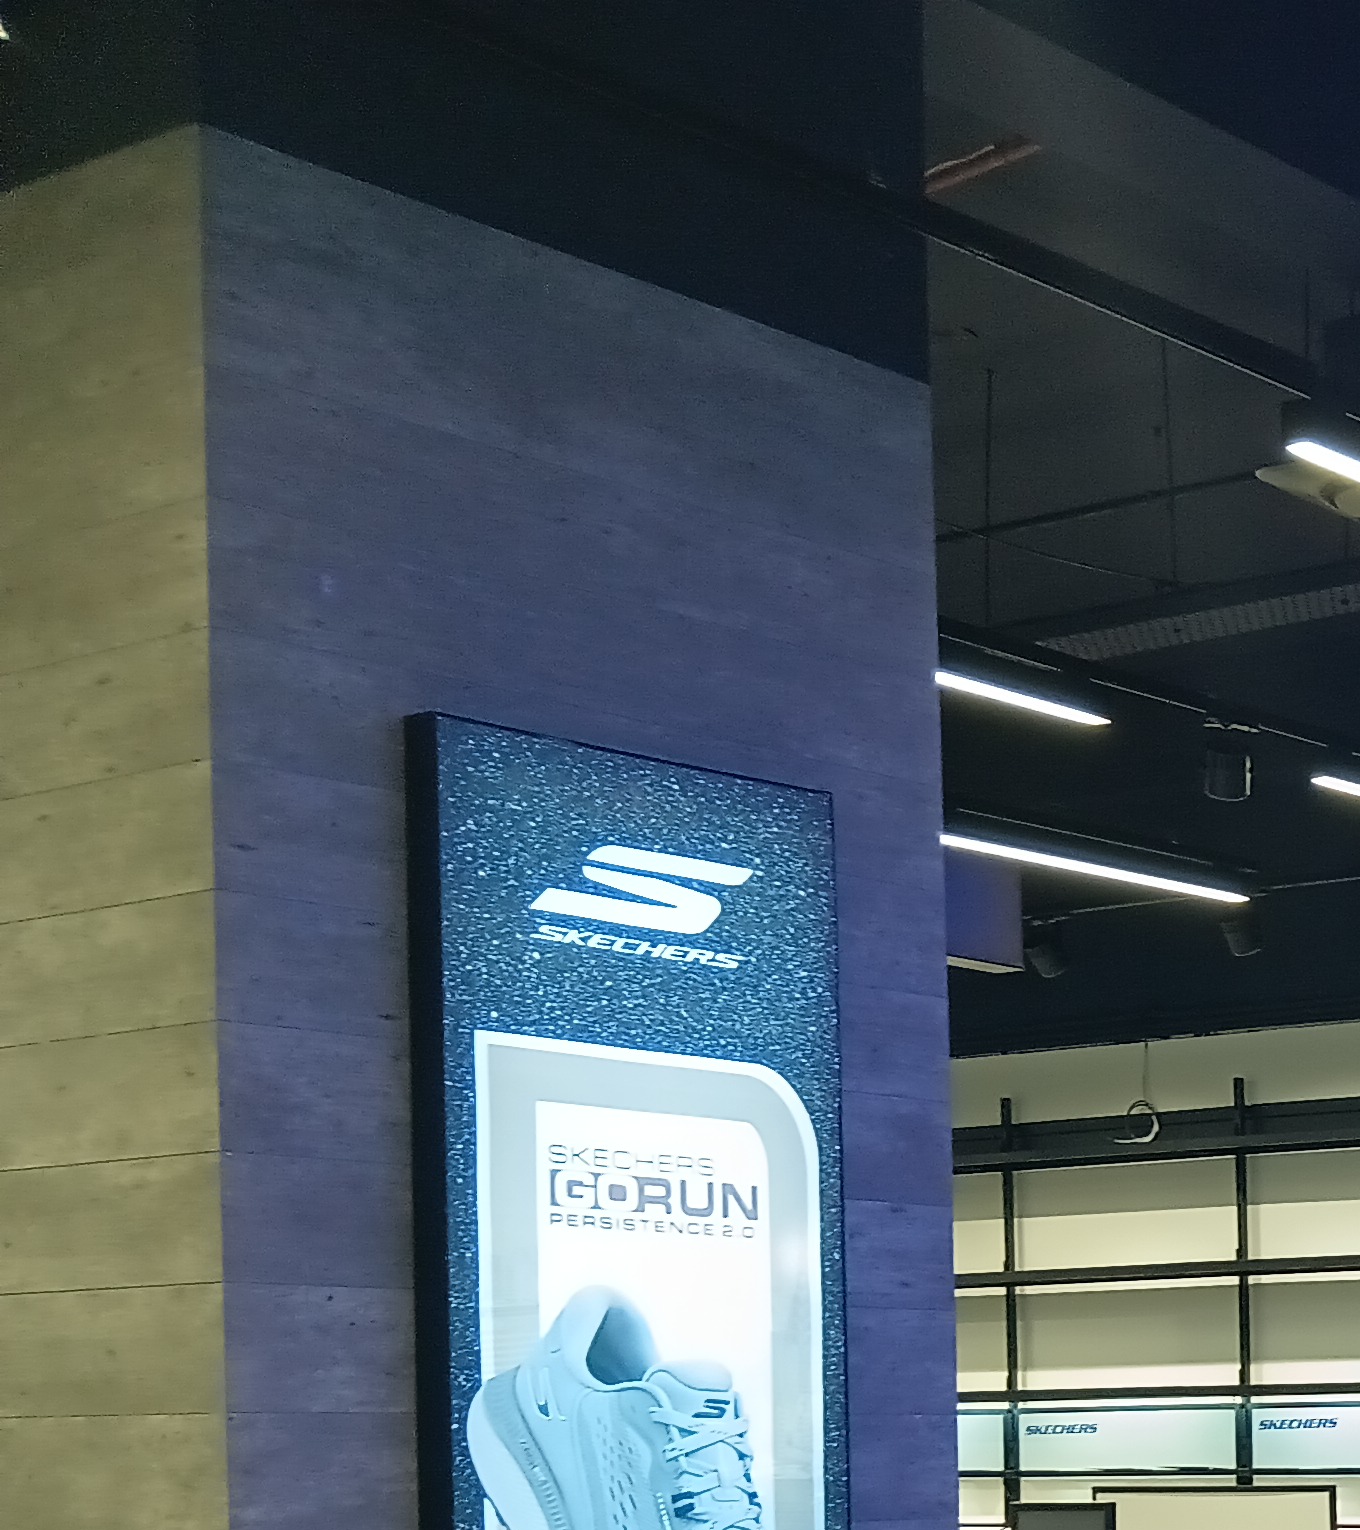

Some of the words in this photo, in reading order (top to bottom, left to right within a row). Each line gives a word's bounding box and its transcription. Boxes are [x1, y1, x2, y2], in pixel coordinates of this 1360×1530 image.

[532, 924, 746, 968] SKECHERS
[548, 1144, 716, 1176] SKECHERS
[549, 1212, 715, 1236] PERSISTENCE
[1024, 1423, 1098, 1436] SKECHERS
[1258, 1417, 1339, 1431] SKECHERS
